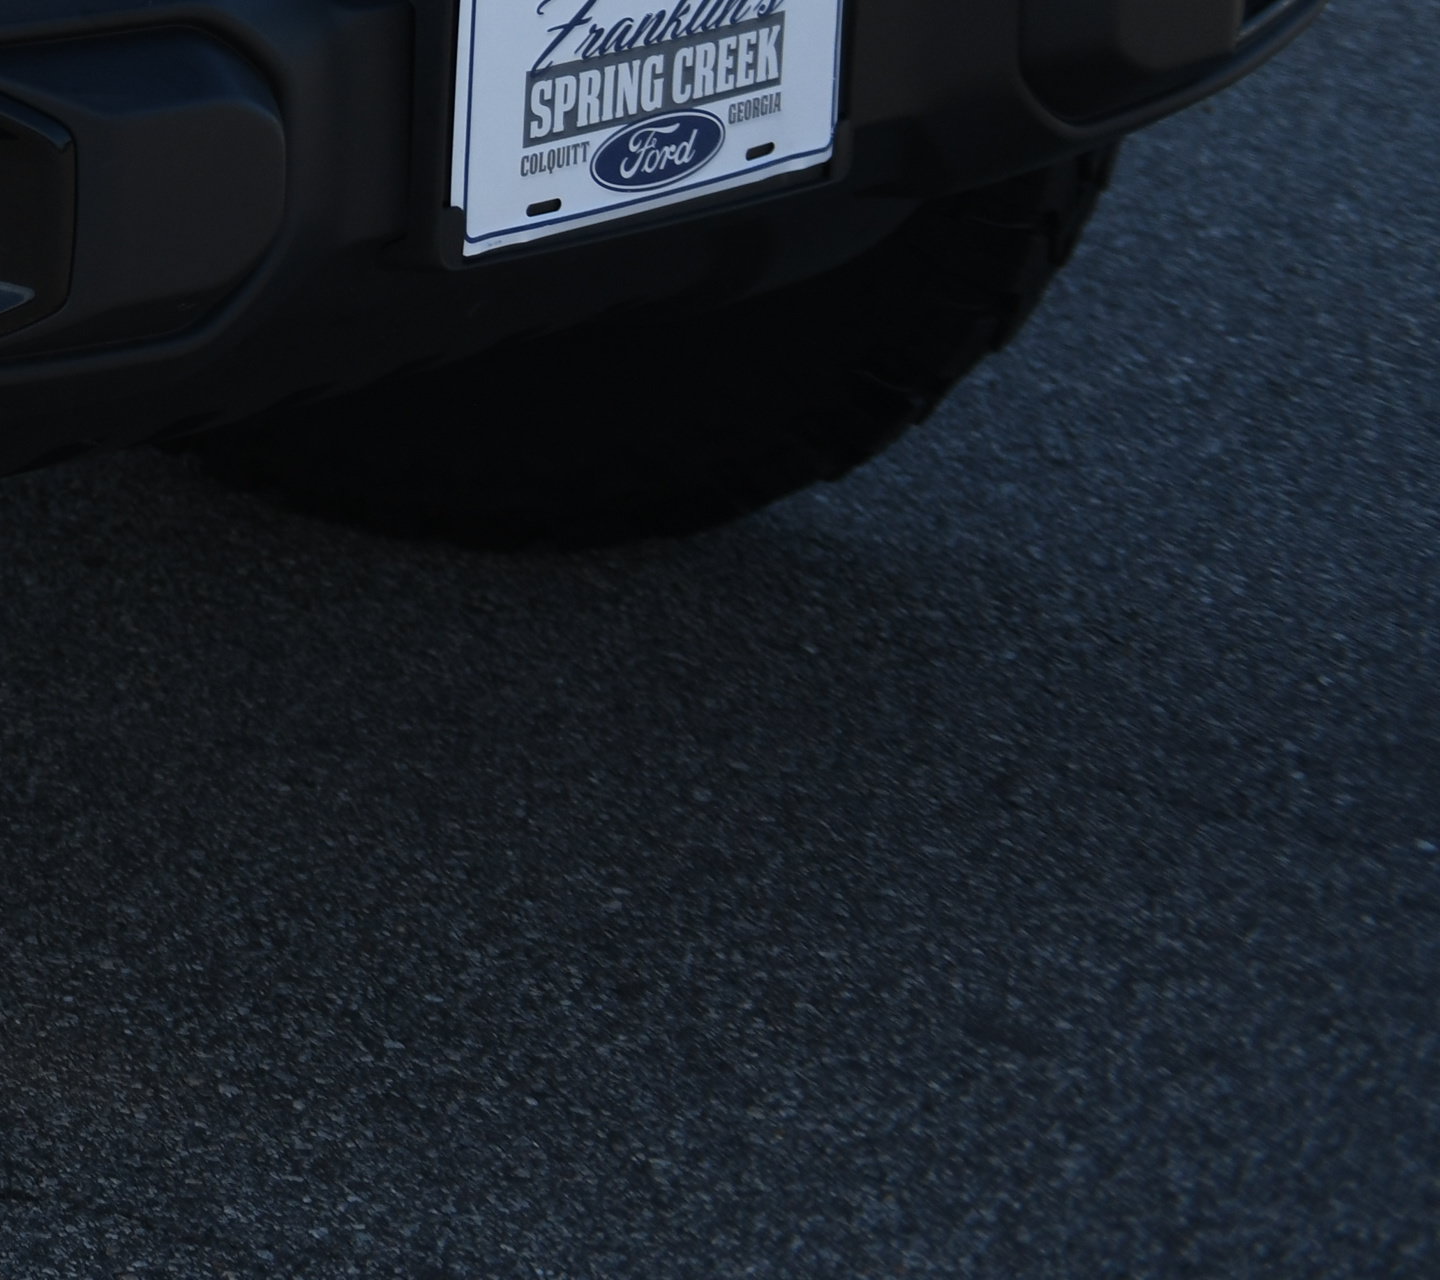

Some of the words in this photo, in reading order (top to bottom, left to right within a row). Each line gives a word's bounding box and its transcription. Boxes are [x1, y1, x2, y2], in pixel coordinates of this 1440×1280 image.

[528, 54, 665, 138] SPRING
[672, 24, 781, 104] CREEK
[727, 92, 782, 125] GEORGIA
[520, 142, 590, 177] COLQUITT
[619, 124, 697, 180] Ford
